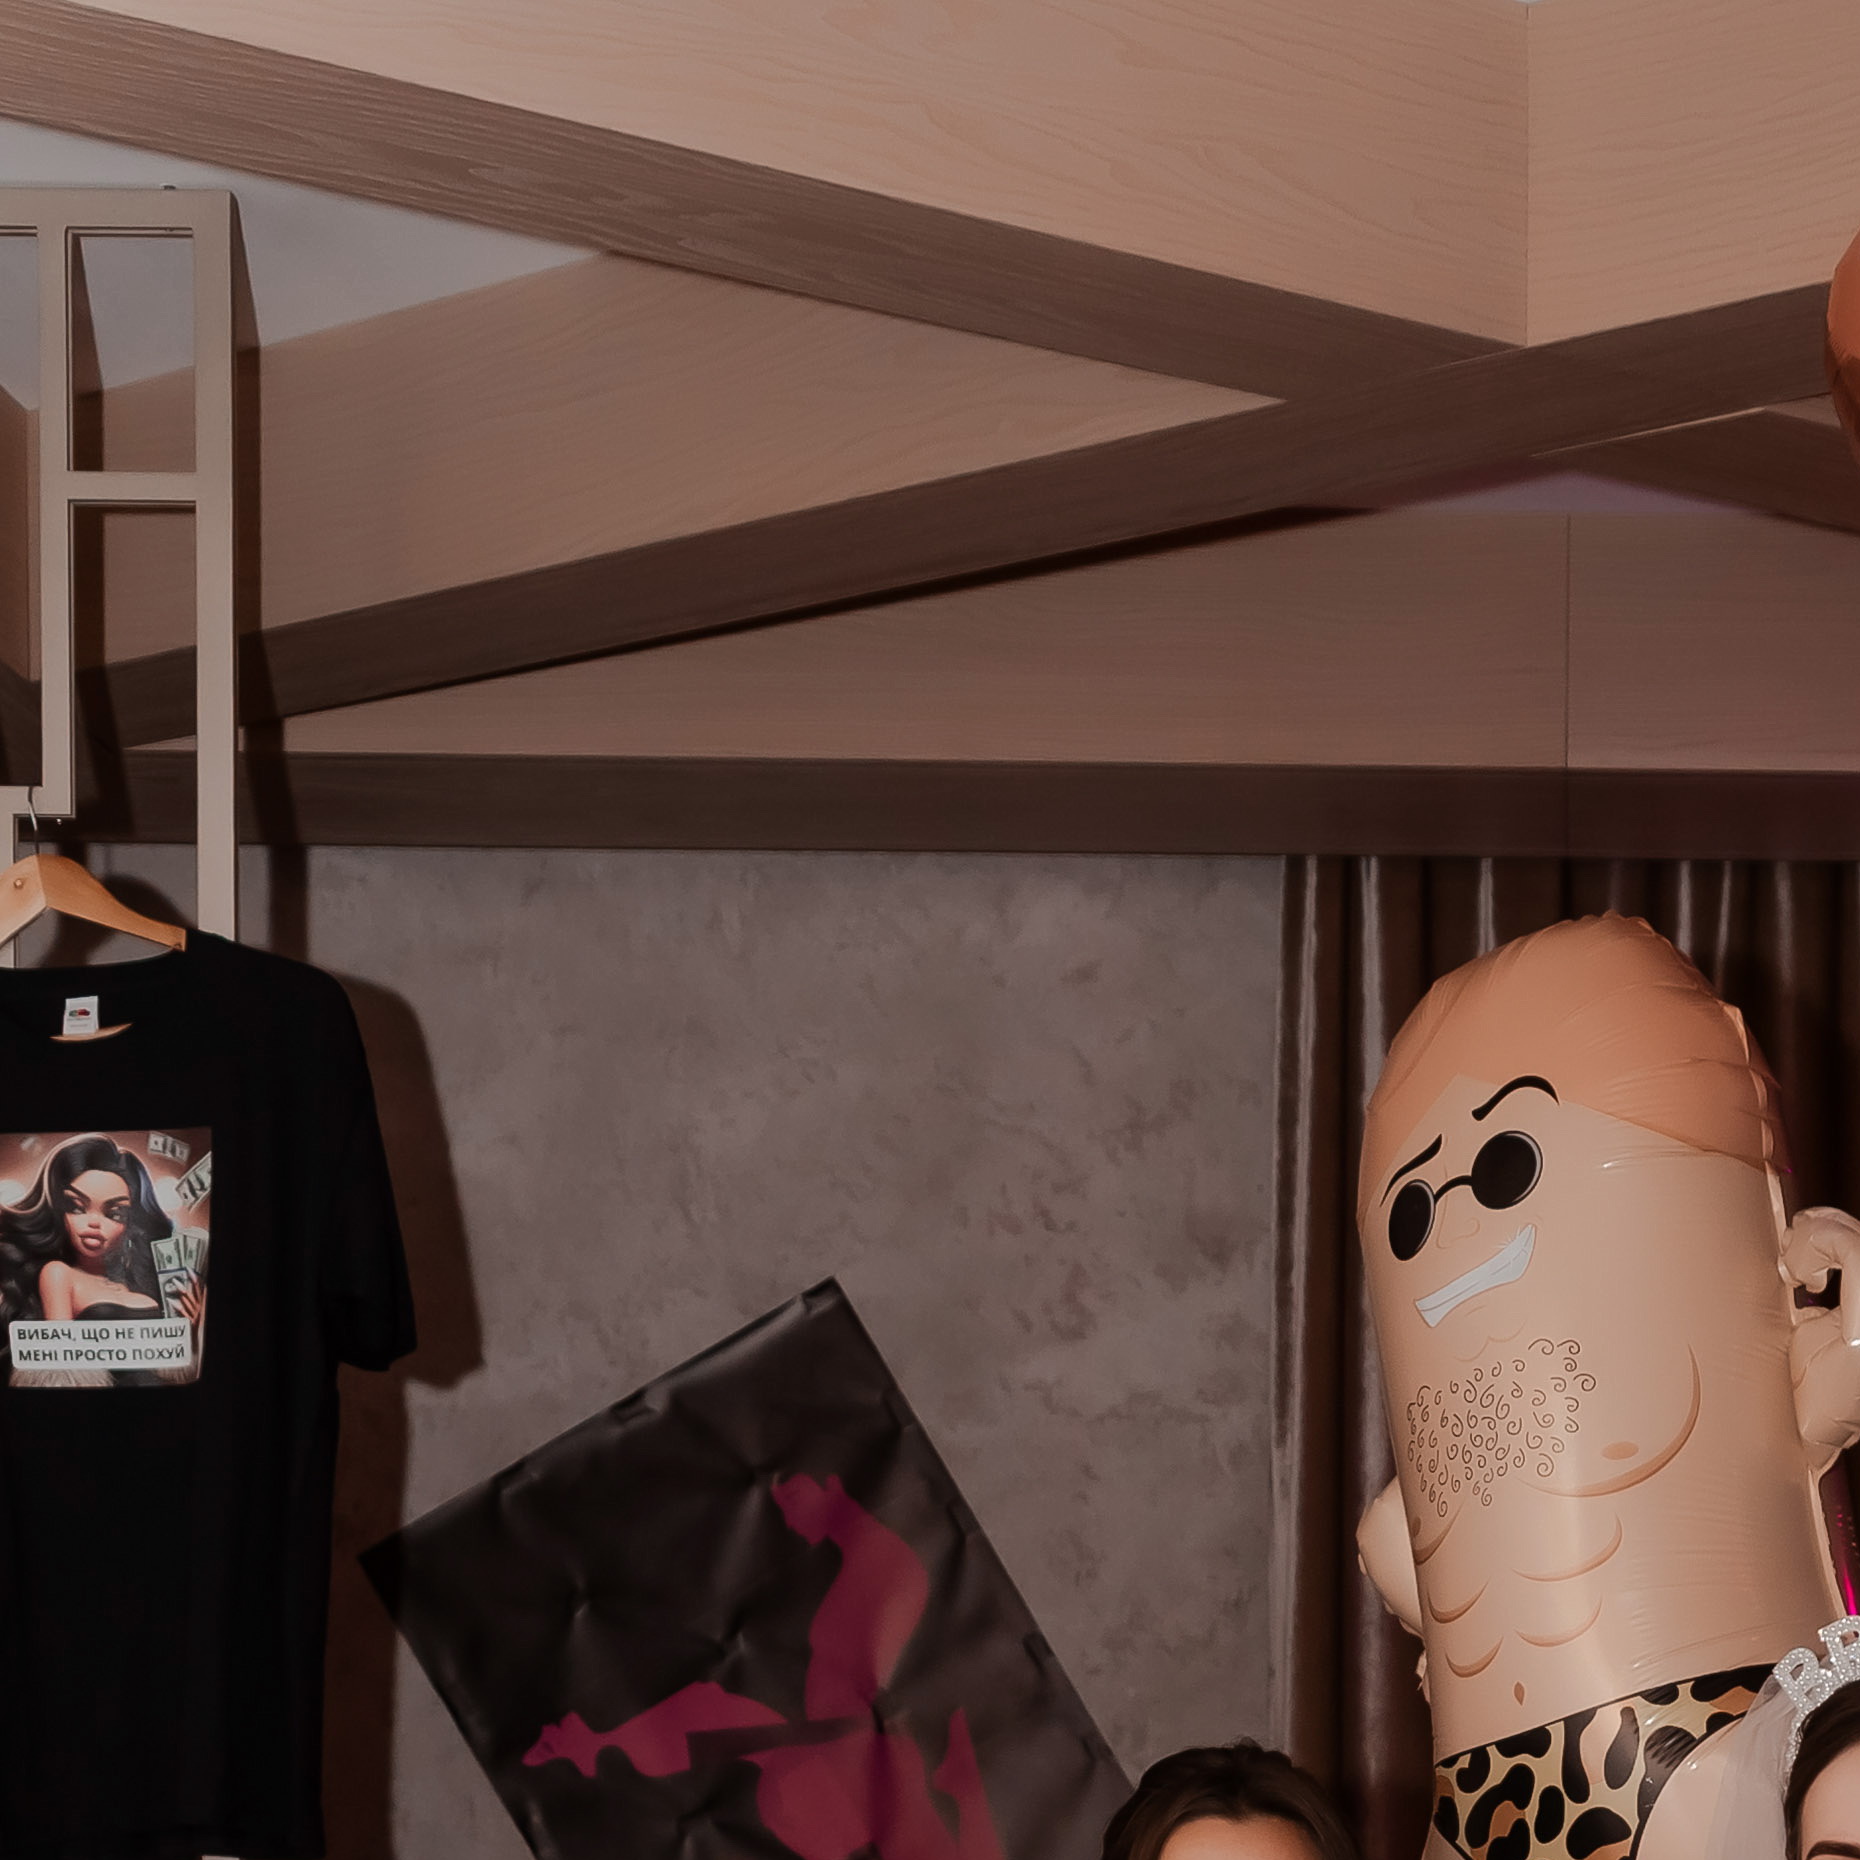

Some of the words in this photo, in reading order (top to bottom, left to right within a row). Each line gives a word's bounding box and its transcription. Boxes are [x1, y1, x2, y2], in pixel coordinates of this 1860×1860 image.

[17, 1325, 77, 1343] ВИБАЧ,
[81, 1325, 110, 1344] ЩО
[115, 1326, 136, 1340] НЕ
[139, 1323, 187, 1341] ПИШУ
[18, 1347, 59, 1362] МЕНІ
[63, 1347, 128, 1362] ПРОСТО
[132, 1343, 186, 1362] ПОХУЙ
